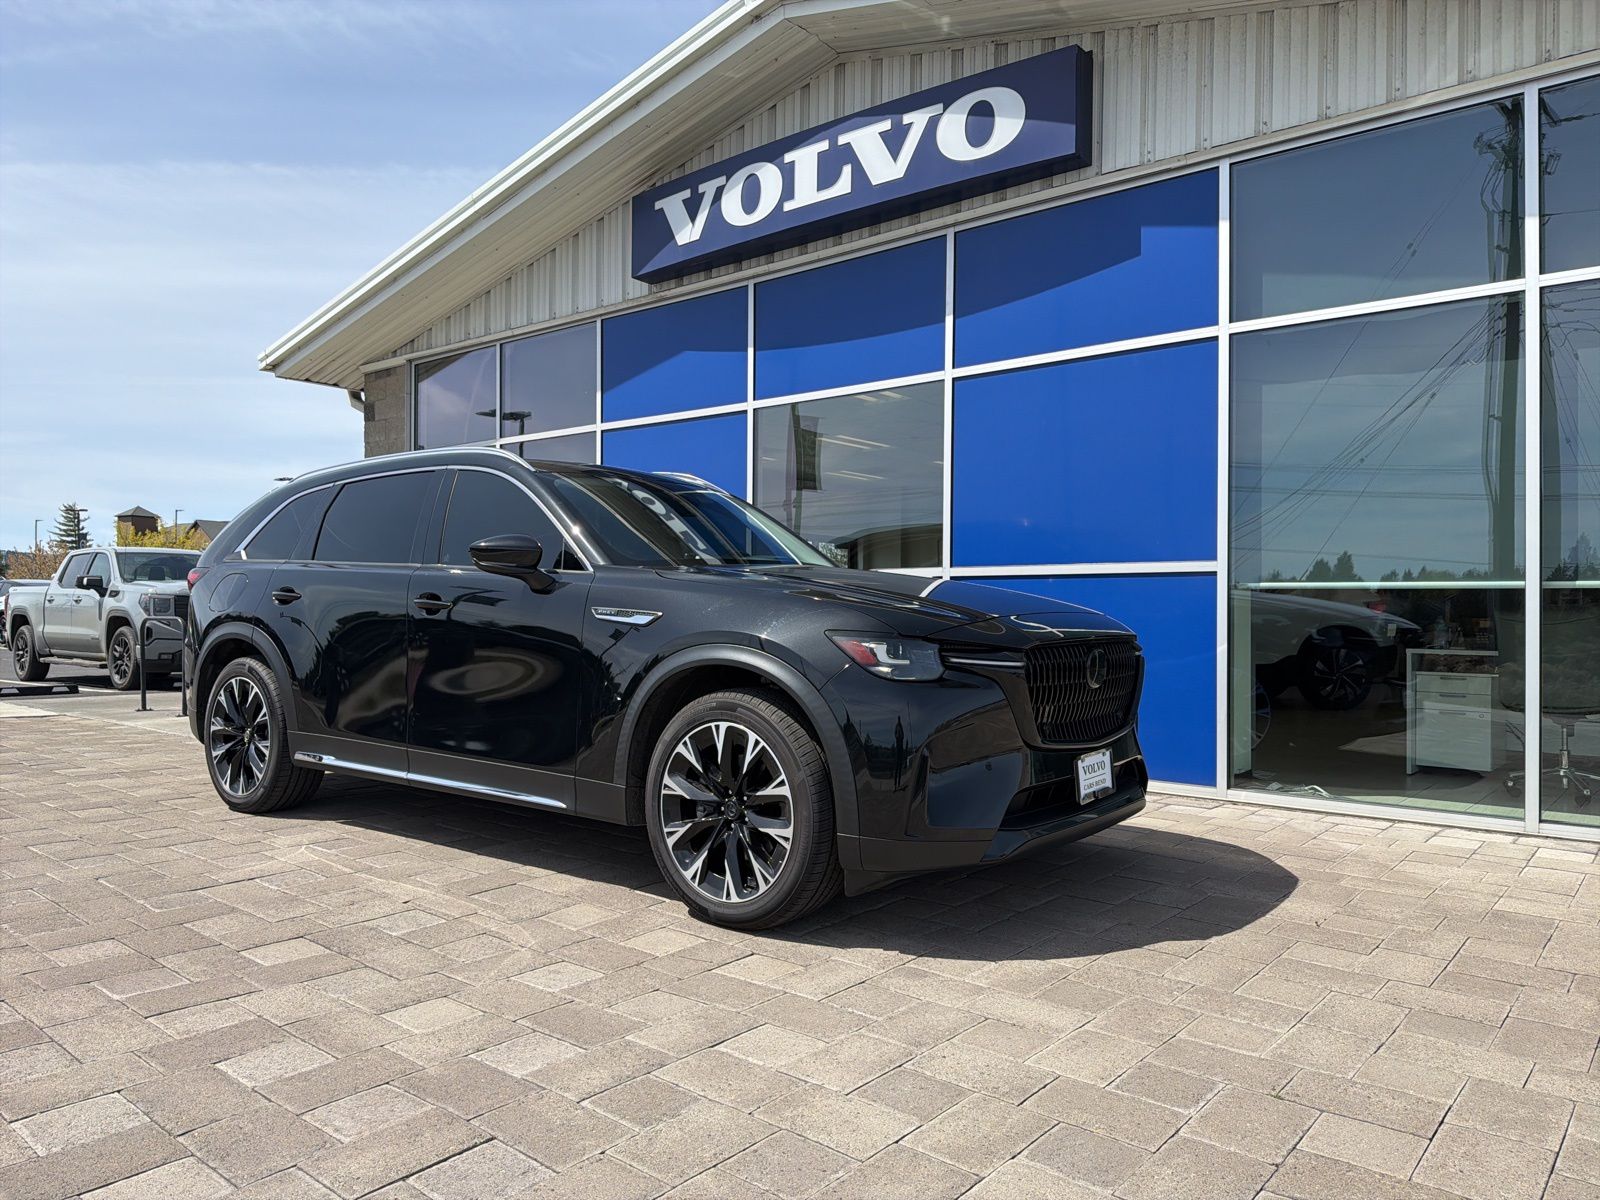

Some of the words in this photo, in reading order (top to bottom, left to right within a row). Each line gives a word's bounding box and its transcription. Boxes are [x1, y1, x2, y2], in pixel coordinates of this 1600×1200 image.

[654, 86, 1026, 247] VOLVO
[1082, 760, 1106, 776] VOLVO
[1084, 782, 1095, 791] CARS
